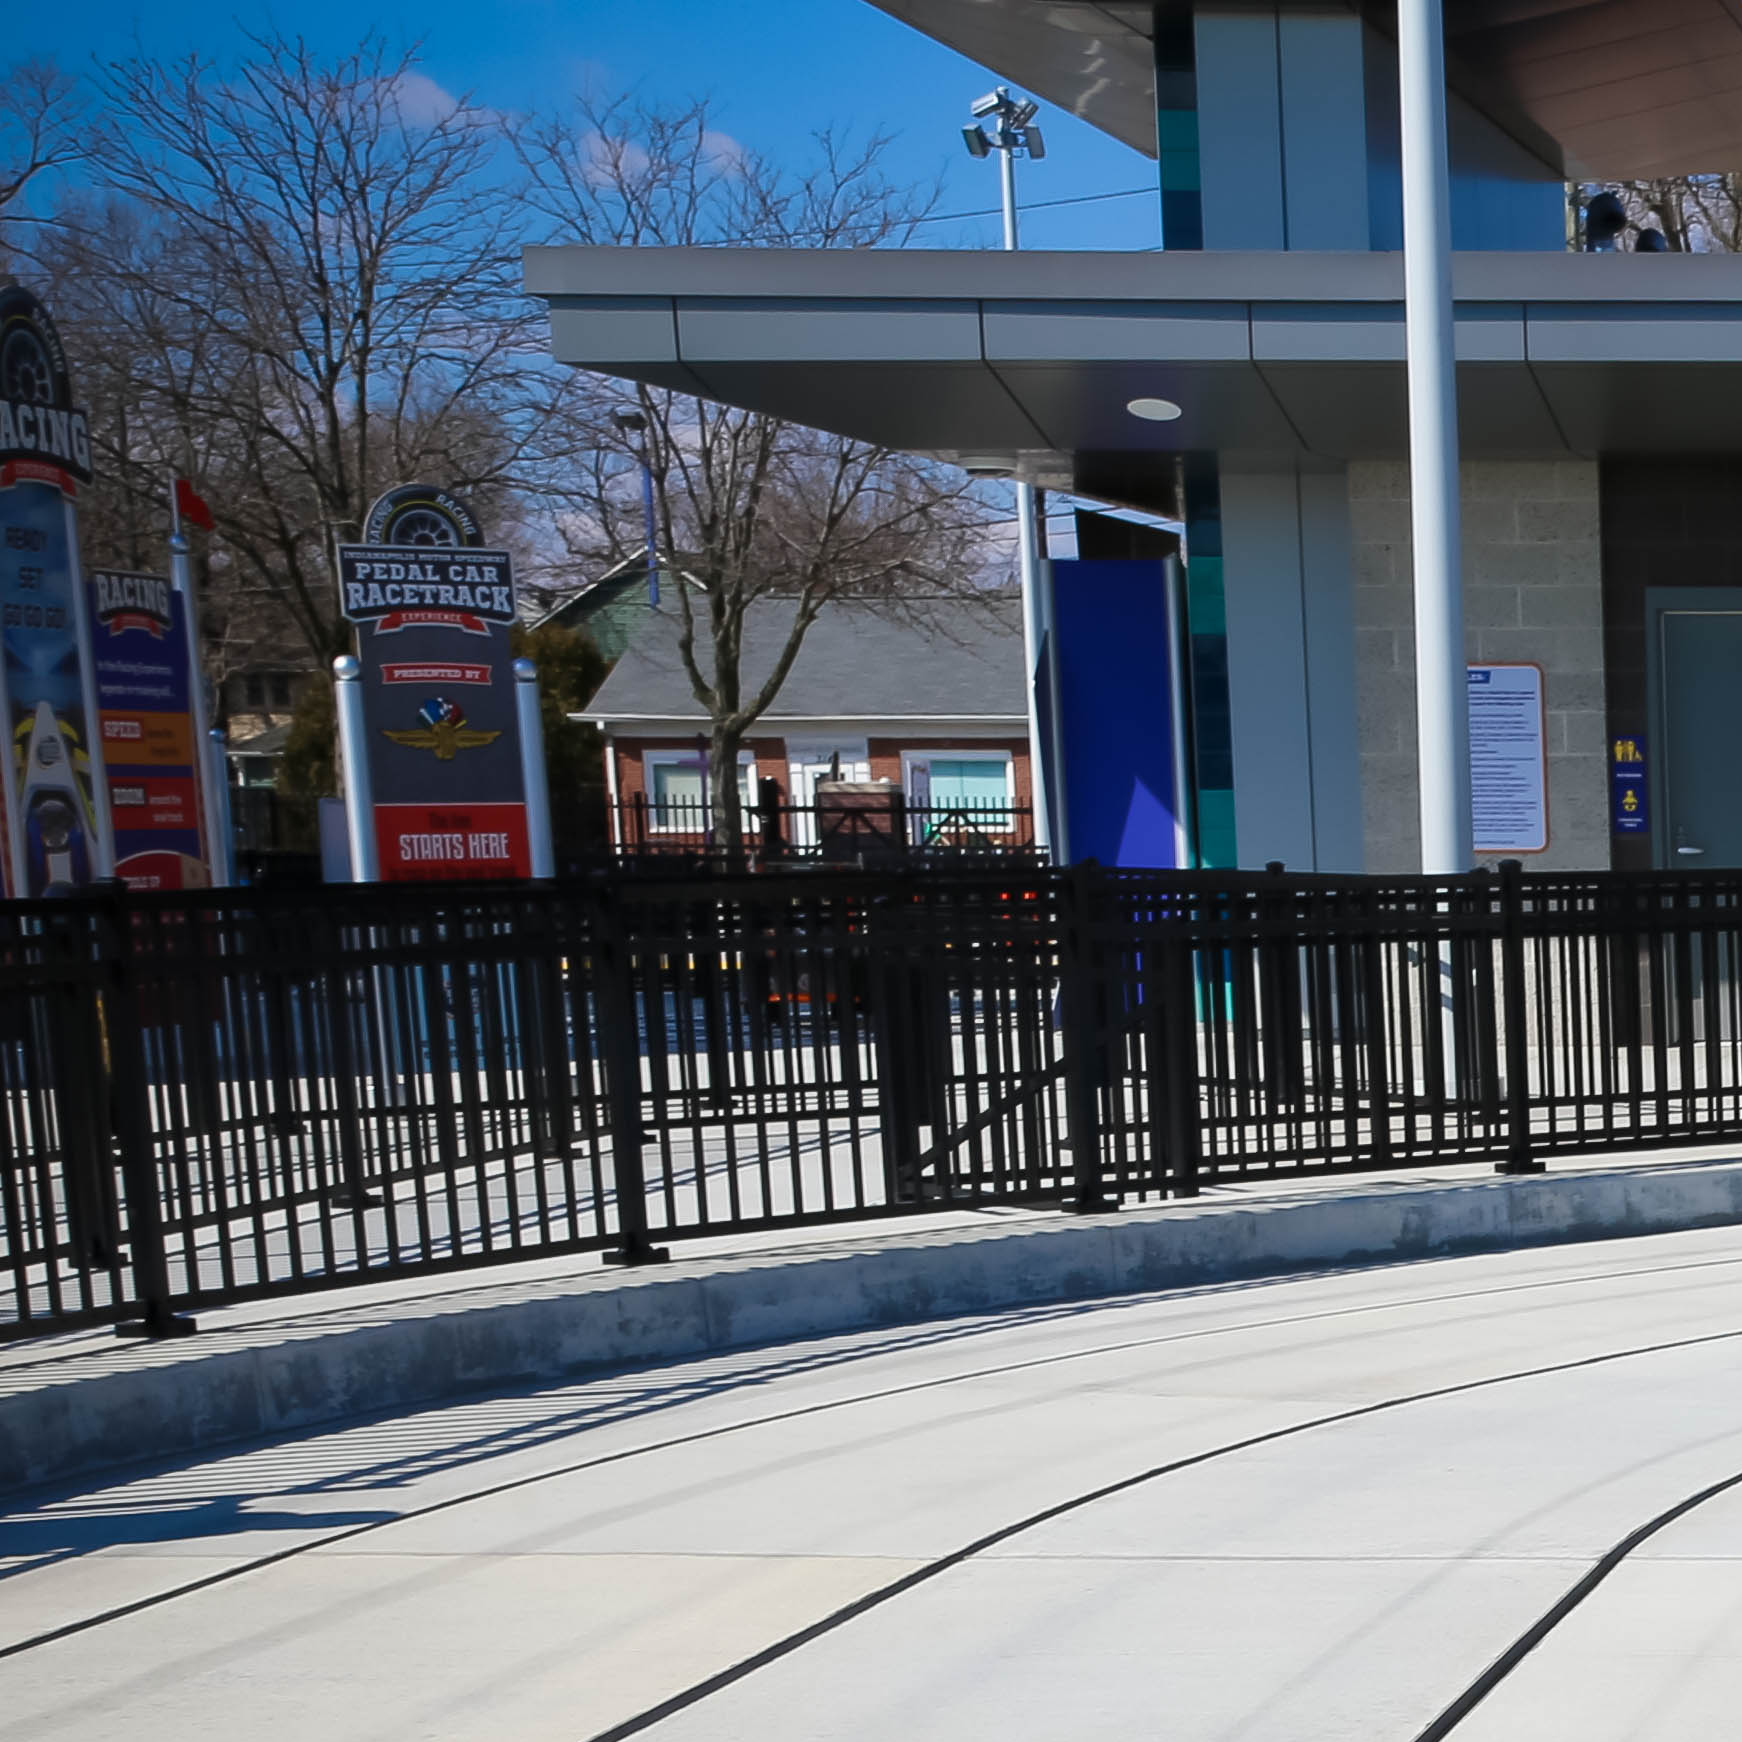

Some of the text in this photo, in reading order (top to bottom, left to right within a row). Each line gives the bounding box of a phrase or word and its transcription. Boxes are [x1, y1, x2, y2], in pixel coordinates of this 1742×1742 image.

[355, 563, 499, 583] PEDAL CAR
[96, 573, 169, 618] RACING
[346, 582, 512, 613] RACETRACK
[399, 832, 510, 861] STARTS HERE
